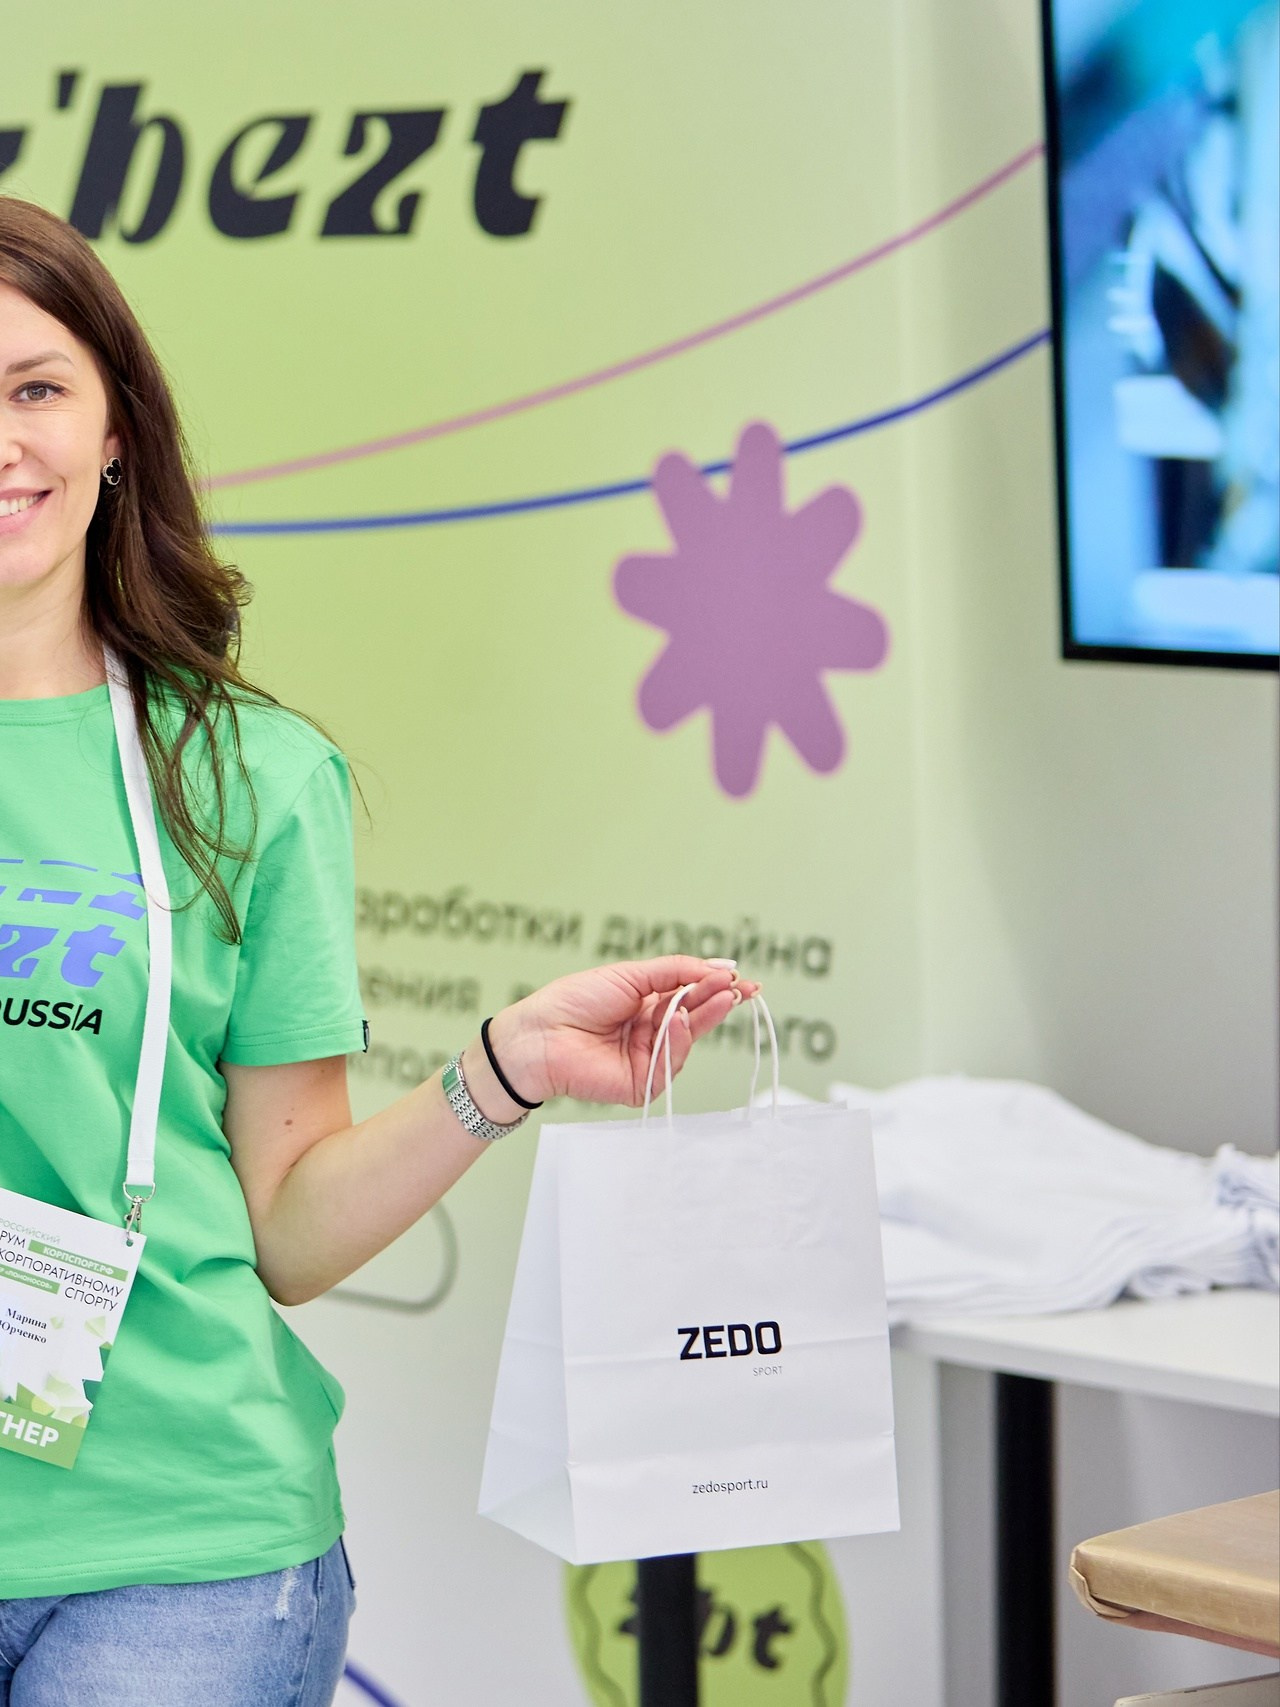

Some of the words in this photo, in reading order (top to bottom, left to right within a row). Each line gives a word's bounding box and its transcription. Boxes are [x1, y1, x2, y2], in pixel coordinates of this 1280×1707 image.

[42, 1245, 115, 1276] КОРПСПОРТ.РФ
[64, 1286, 119, 1312] СПОРТУ
[6, 1307, 48, 1330] Марина
[677, 1320, 784, 1361] ZEDO
[752, 1365, 784, 1377] SPORT
[692, 1478, 769, 1494] zedosport.ru
